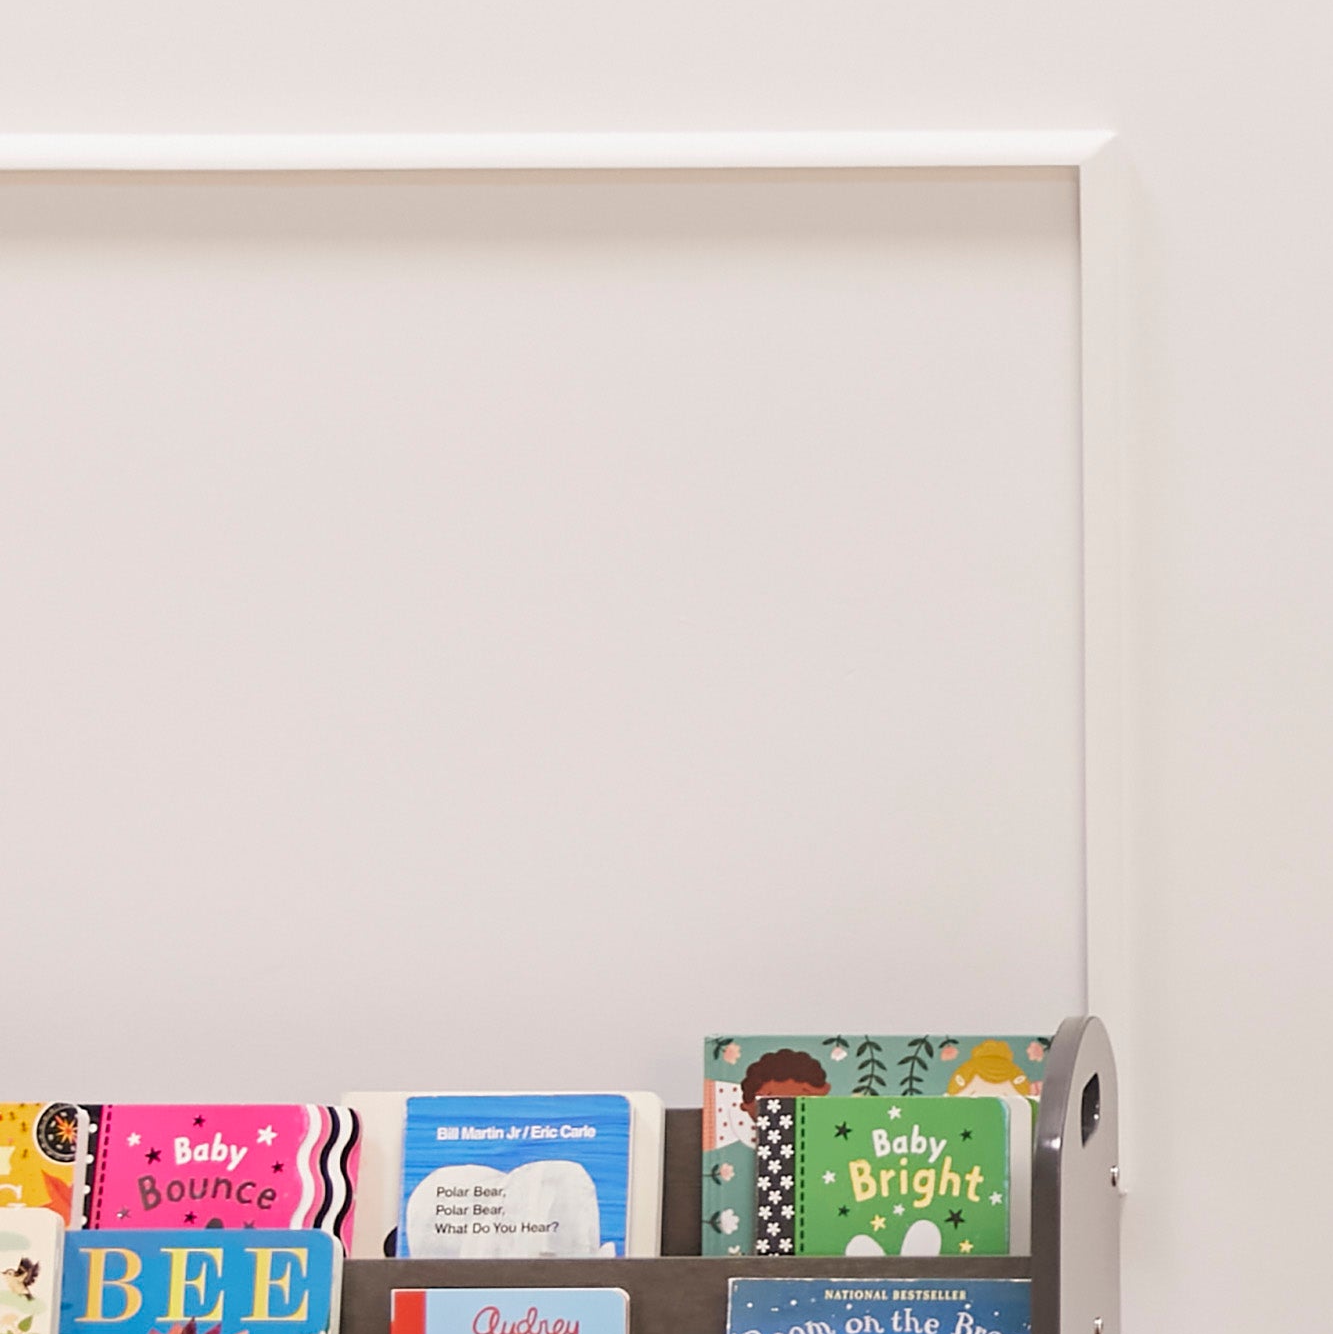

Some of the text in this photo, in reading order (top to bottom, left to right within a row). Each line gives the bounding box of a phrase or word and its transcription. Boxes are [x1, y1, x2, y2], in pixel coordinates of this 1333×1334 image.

[435, 1126, 460, 1141] Bill
[461, 1126, 505, 1141] Martin
[506, 1126, 521, 1140] Jr
[530, 1125, 559, 1140] Eric
[559, 1124, 597, 1139] Carle
[174, 1132, 249, 1172] Baby
[871, 1124, 948, 1164] Baby
[435, 1185, 507, 1199] Polar Bear,
[848, 1156, 985, 1209] Bright
[137, 1175, 278, 1212] Bounce
[435, 1203, 506, 1217] Polar Bear,
[434, 1221, 560, 1235] What Do You Hear?
[74, 1247, 310, 1323] BEE
[824, 1289, 967, 1301] NATIONAL BESTSELLER
[844, 1314, 885, 1334] on
